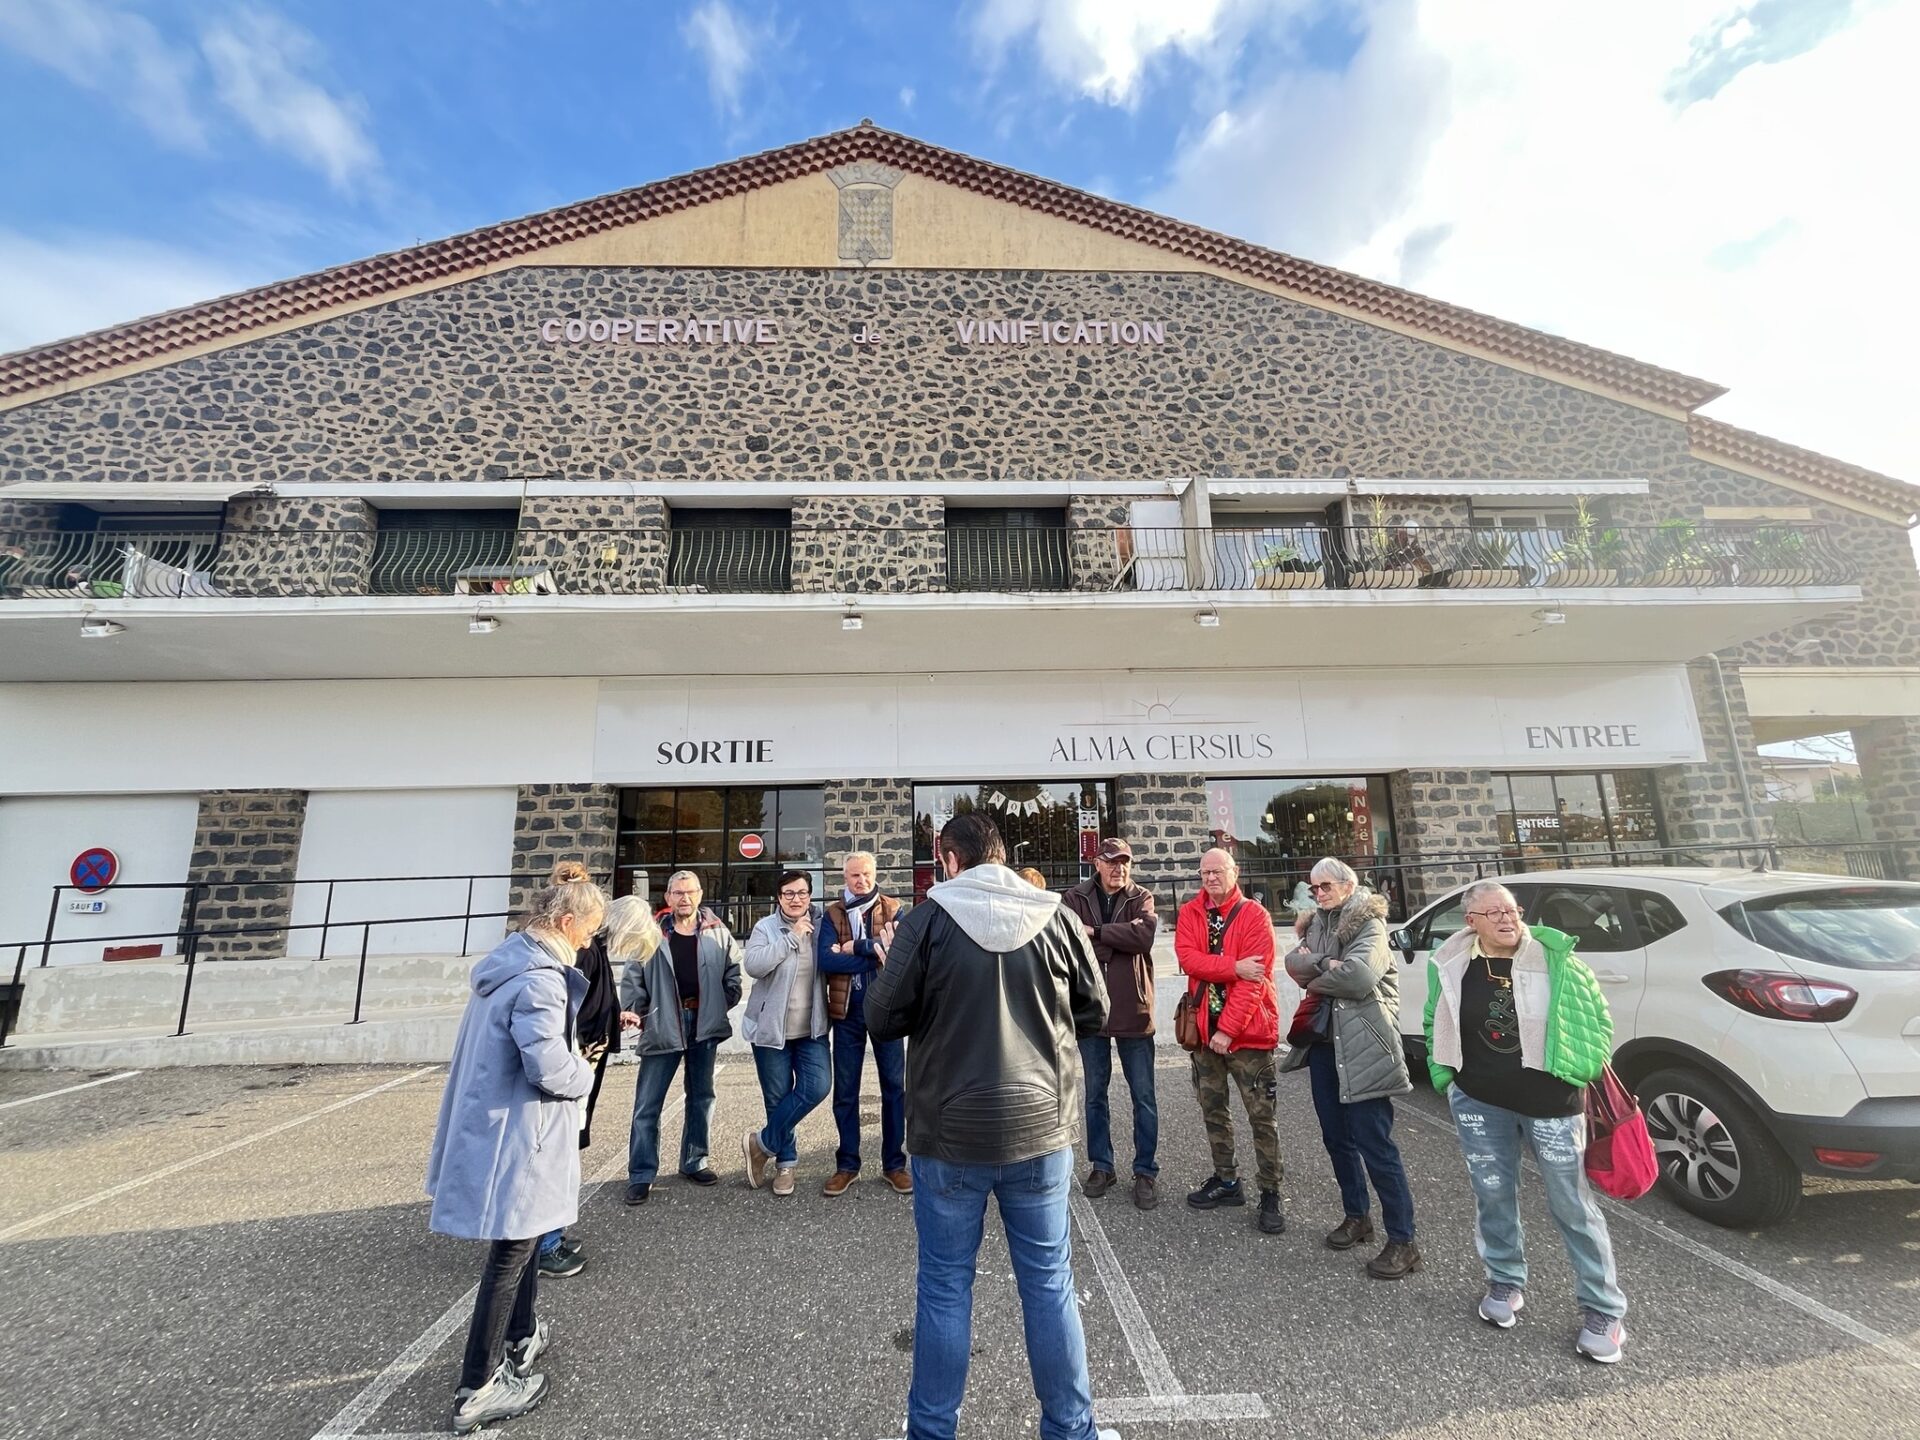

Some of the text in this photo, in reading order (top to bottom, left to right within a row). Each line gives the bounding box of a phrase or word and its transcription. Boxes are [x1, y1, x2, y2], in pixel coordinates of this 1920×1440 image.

[834, 165, 900, 184] 1949
[541, 319, 1165, 345] COOPERATIVE de VINIFICATION
[1049, 733, 1273, 762] ALMA CERSIUS
[1525, 724, 1641, 749] ENTREE
[656, 739, 774, 765] SORTIE
[1217, 789, 1234, 856] Joyeu
[1353, 795, 1369, 857] Noël
[1516, 816, 1560, 829] ENTRÉE
[70, 902, 92, 911] SAUF
